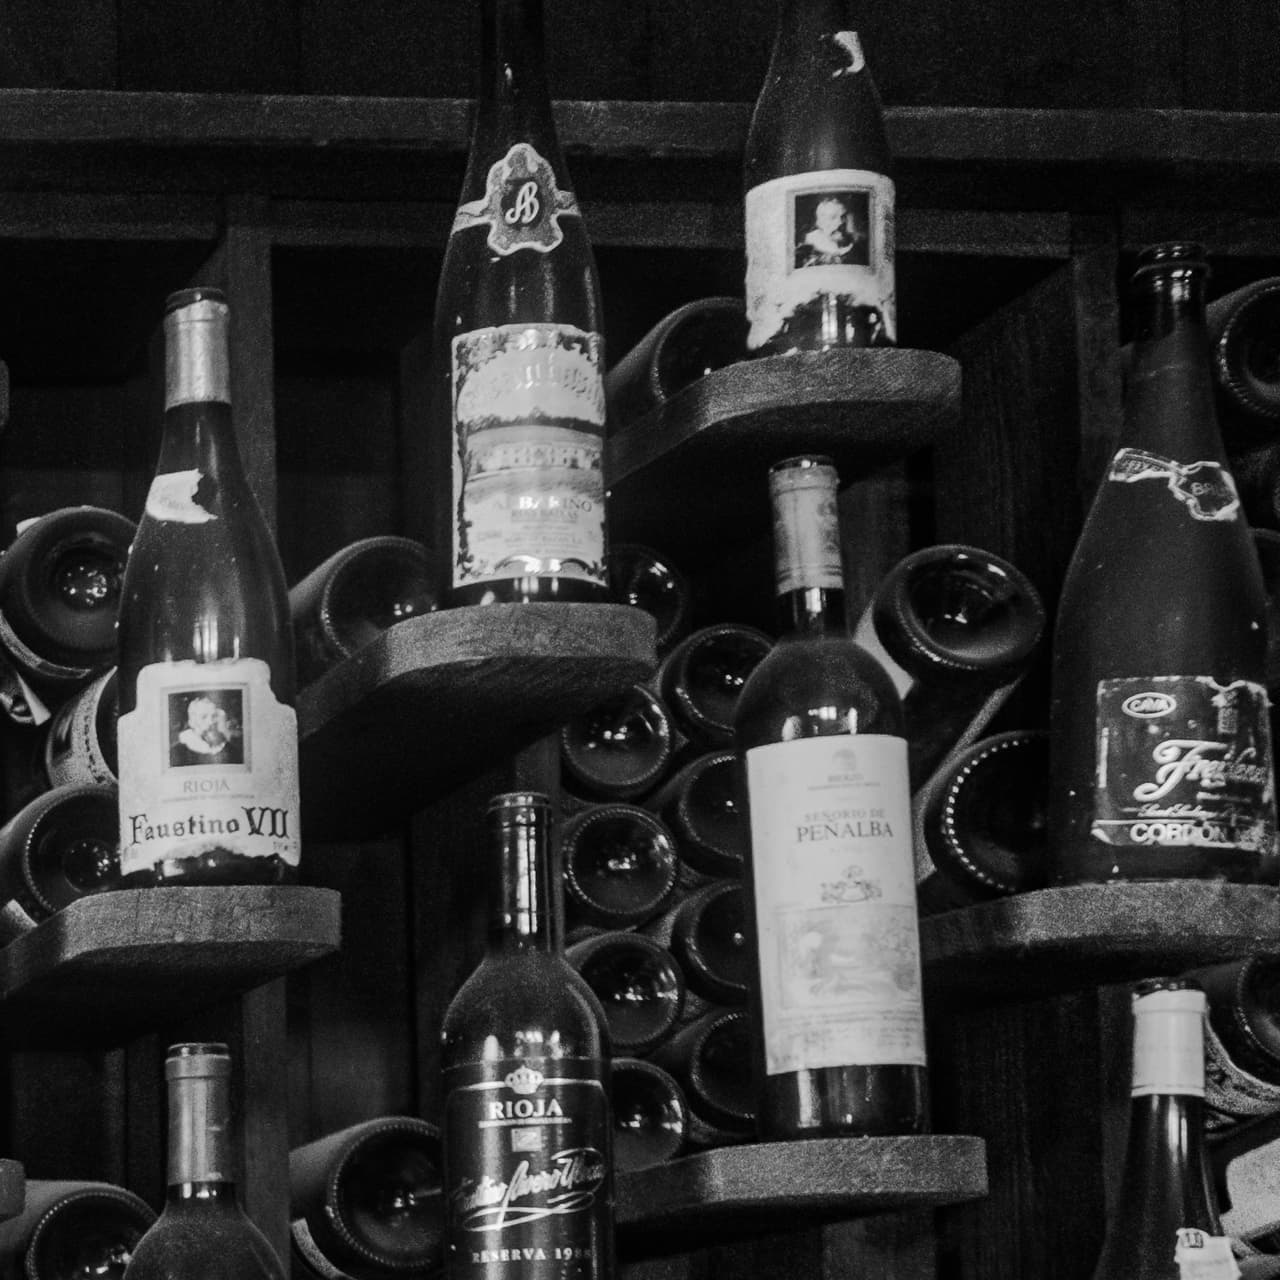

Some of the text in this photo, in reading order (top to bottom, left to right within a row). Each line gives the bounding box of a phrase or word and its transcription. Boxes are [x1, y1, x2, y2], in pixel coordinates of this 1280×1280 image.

[182, 779, 231, 794] RIOJA
[128, 813, 240, 846] Faustino
[488, 1098, 564, 1120] RIOJA
